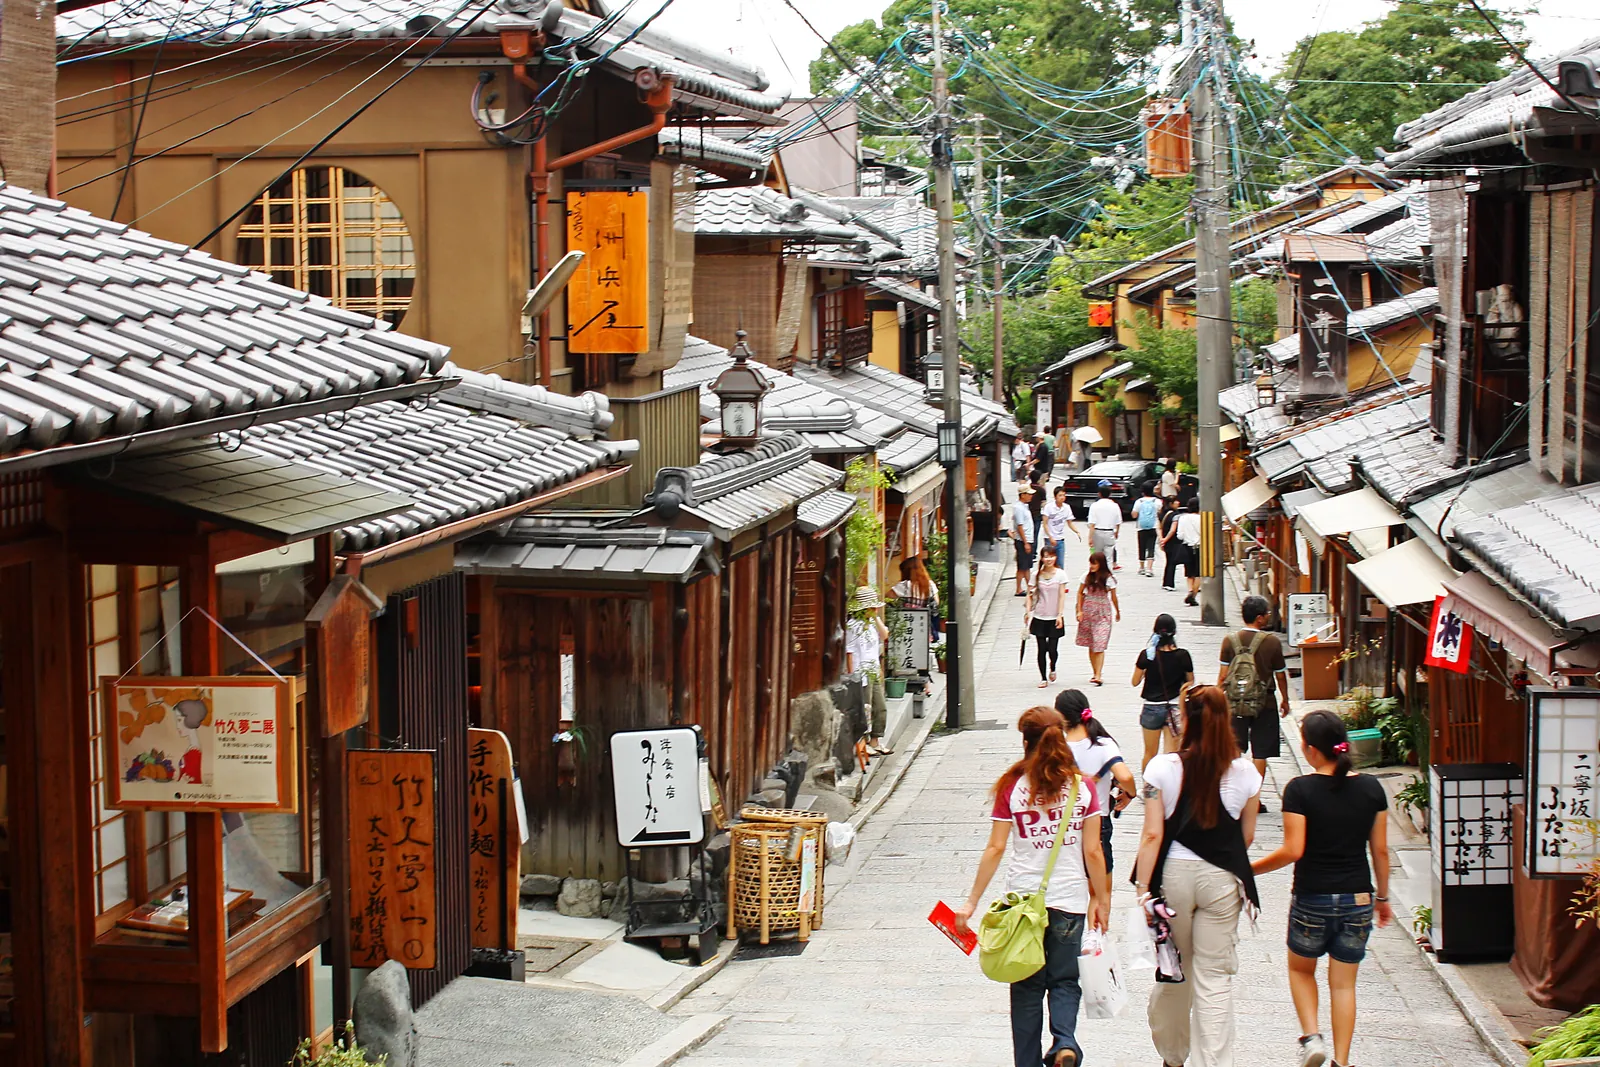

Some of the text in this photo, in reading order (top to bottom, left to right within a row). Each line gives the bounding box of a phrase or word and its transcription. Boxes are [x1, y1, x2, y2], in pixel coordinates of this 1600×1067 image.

[214, 719, 275, 734] 竹久夢二展
[1569, 754, 1592, 818] 二寧坂
[469, 739, 496, 933] 手作り麺 小松うどん
[1032, 836, 1078, 850] WOLD
[1450, 816, 1476, 876] ふたば
[1477, 808, 1496, 860] 二寧坂
[1540, 786, 1568, 858] ふたば
